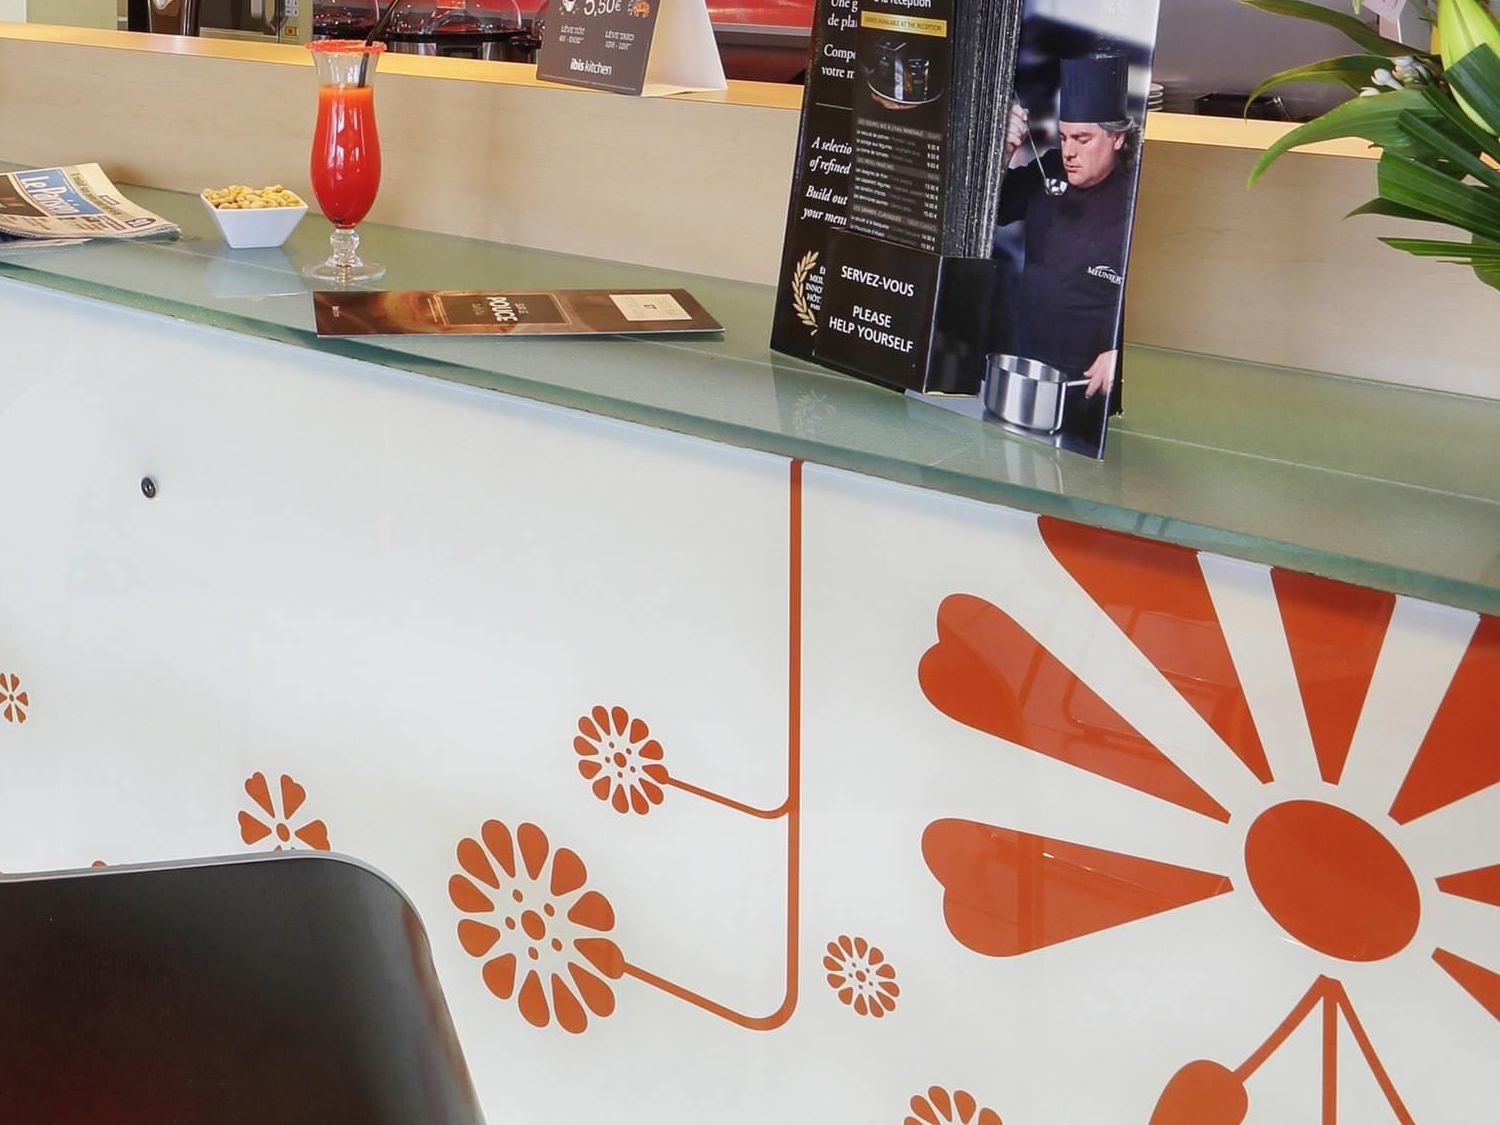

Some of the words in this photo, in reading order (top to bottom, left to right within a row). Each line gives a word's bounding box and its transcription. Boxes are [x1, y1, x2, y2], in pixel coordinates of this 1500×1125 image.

[827, 13, 840, 26] de
[570, 58, 584, 72] ibis
[584, 59, 612, 76] kitchen
[821, 66, 845, 78] votre
[811, 136, 821, 149] A
[809, 156, 822, 172] of
[820, 158, 852, 175] refined
[20, 175, 49, 189] Le
[805, 185, 831, 202] Build
[801, 207, 824, 220] your
[841, 265, 915, 297] SERVEZ-VOUS
[486, 296, 518, 322] POUCE
[852, 305, 892, 328] PLEASE
[828, 316, 855, 334] HELP
[856, 324, 914, 353] YOURSELF
